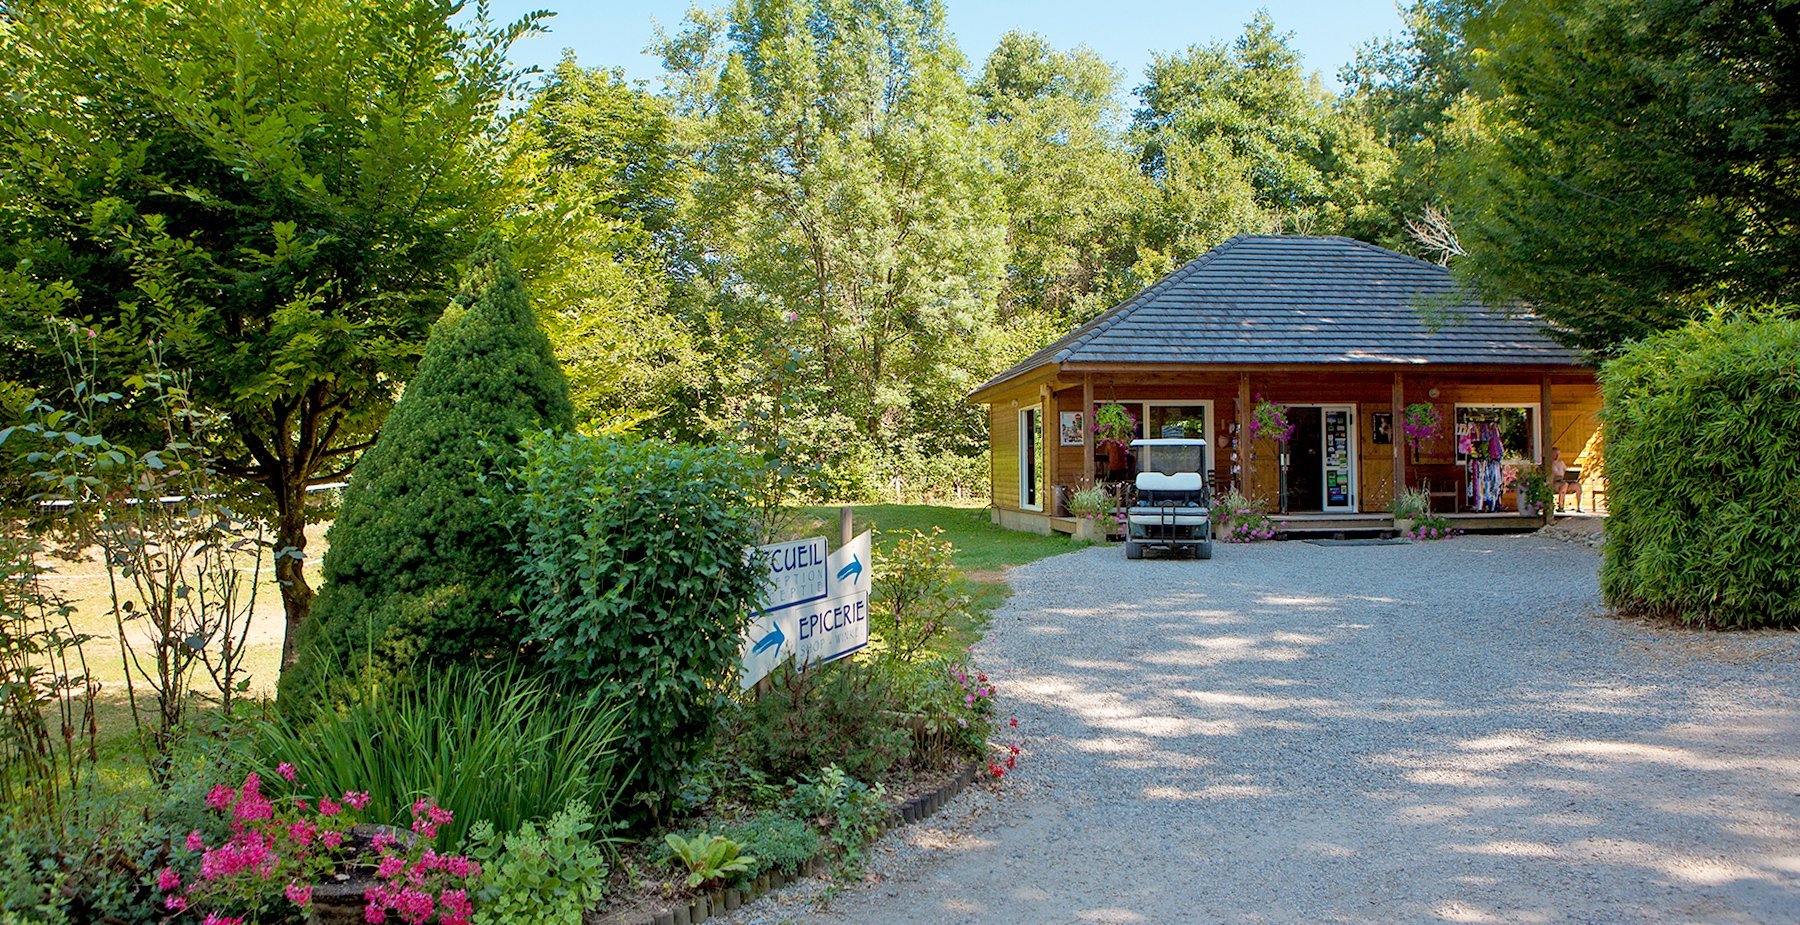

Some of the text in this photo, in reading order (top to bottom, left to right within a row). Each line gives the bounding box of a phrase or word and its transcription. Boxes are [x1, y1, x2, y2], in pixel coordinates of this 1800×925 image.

[750, 543, 823, 573] CUEIL
[769, 581, 823, 604] CEPTIE
[799, 600, 864, 640] EPICERIE
[800, 638, 825, 657] SHOP
